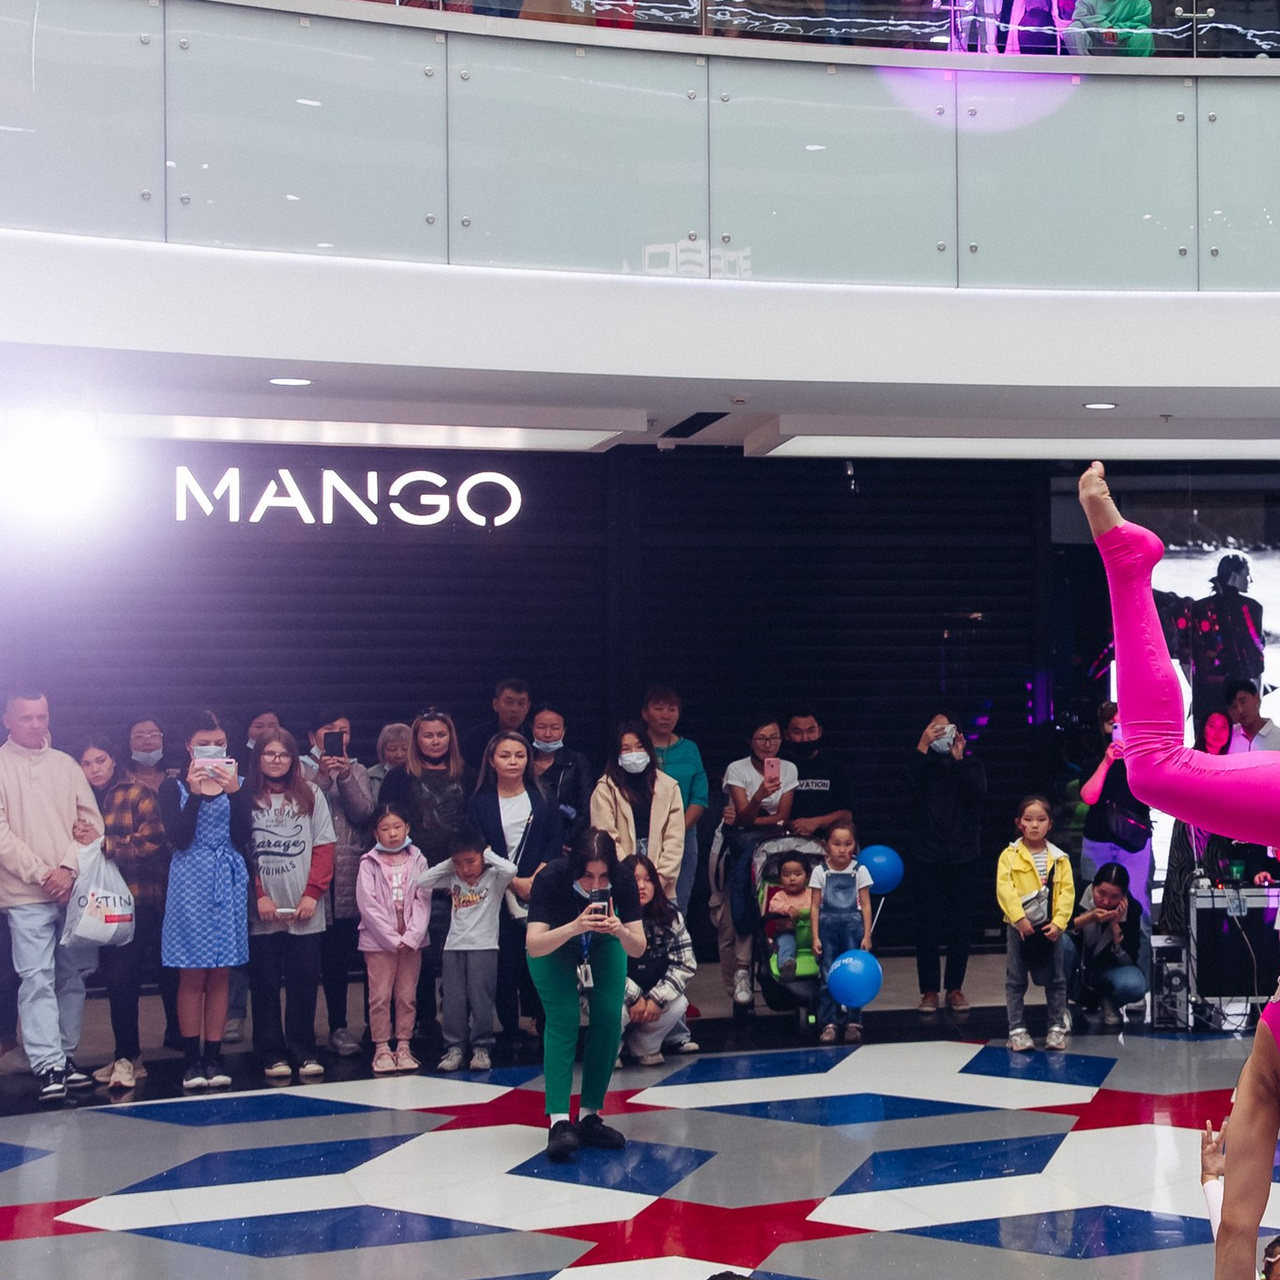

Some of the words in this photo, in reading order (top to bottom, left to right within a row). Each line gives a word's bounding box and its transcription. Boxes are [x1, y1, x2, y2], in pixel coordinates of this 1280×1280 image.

[175, 466, 522, 527] MANGO
[800, 781, 829, 789] VATION
[256, 839, 300, 852] arage
[258, 861, 297, 876] IGINALS
